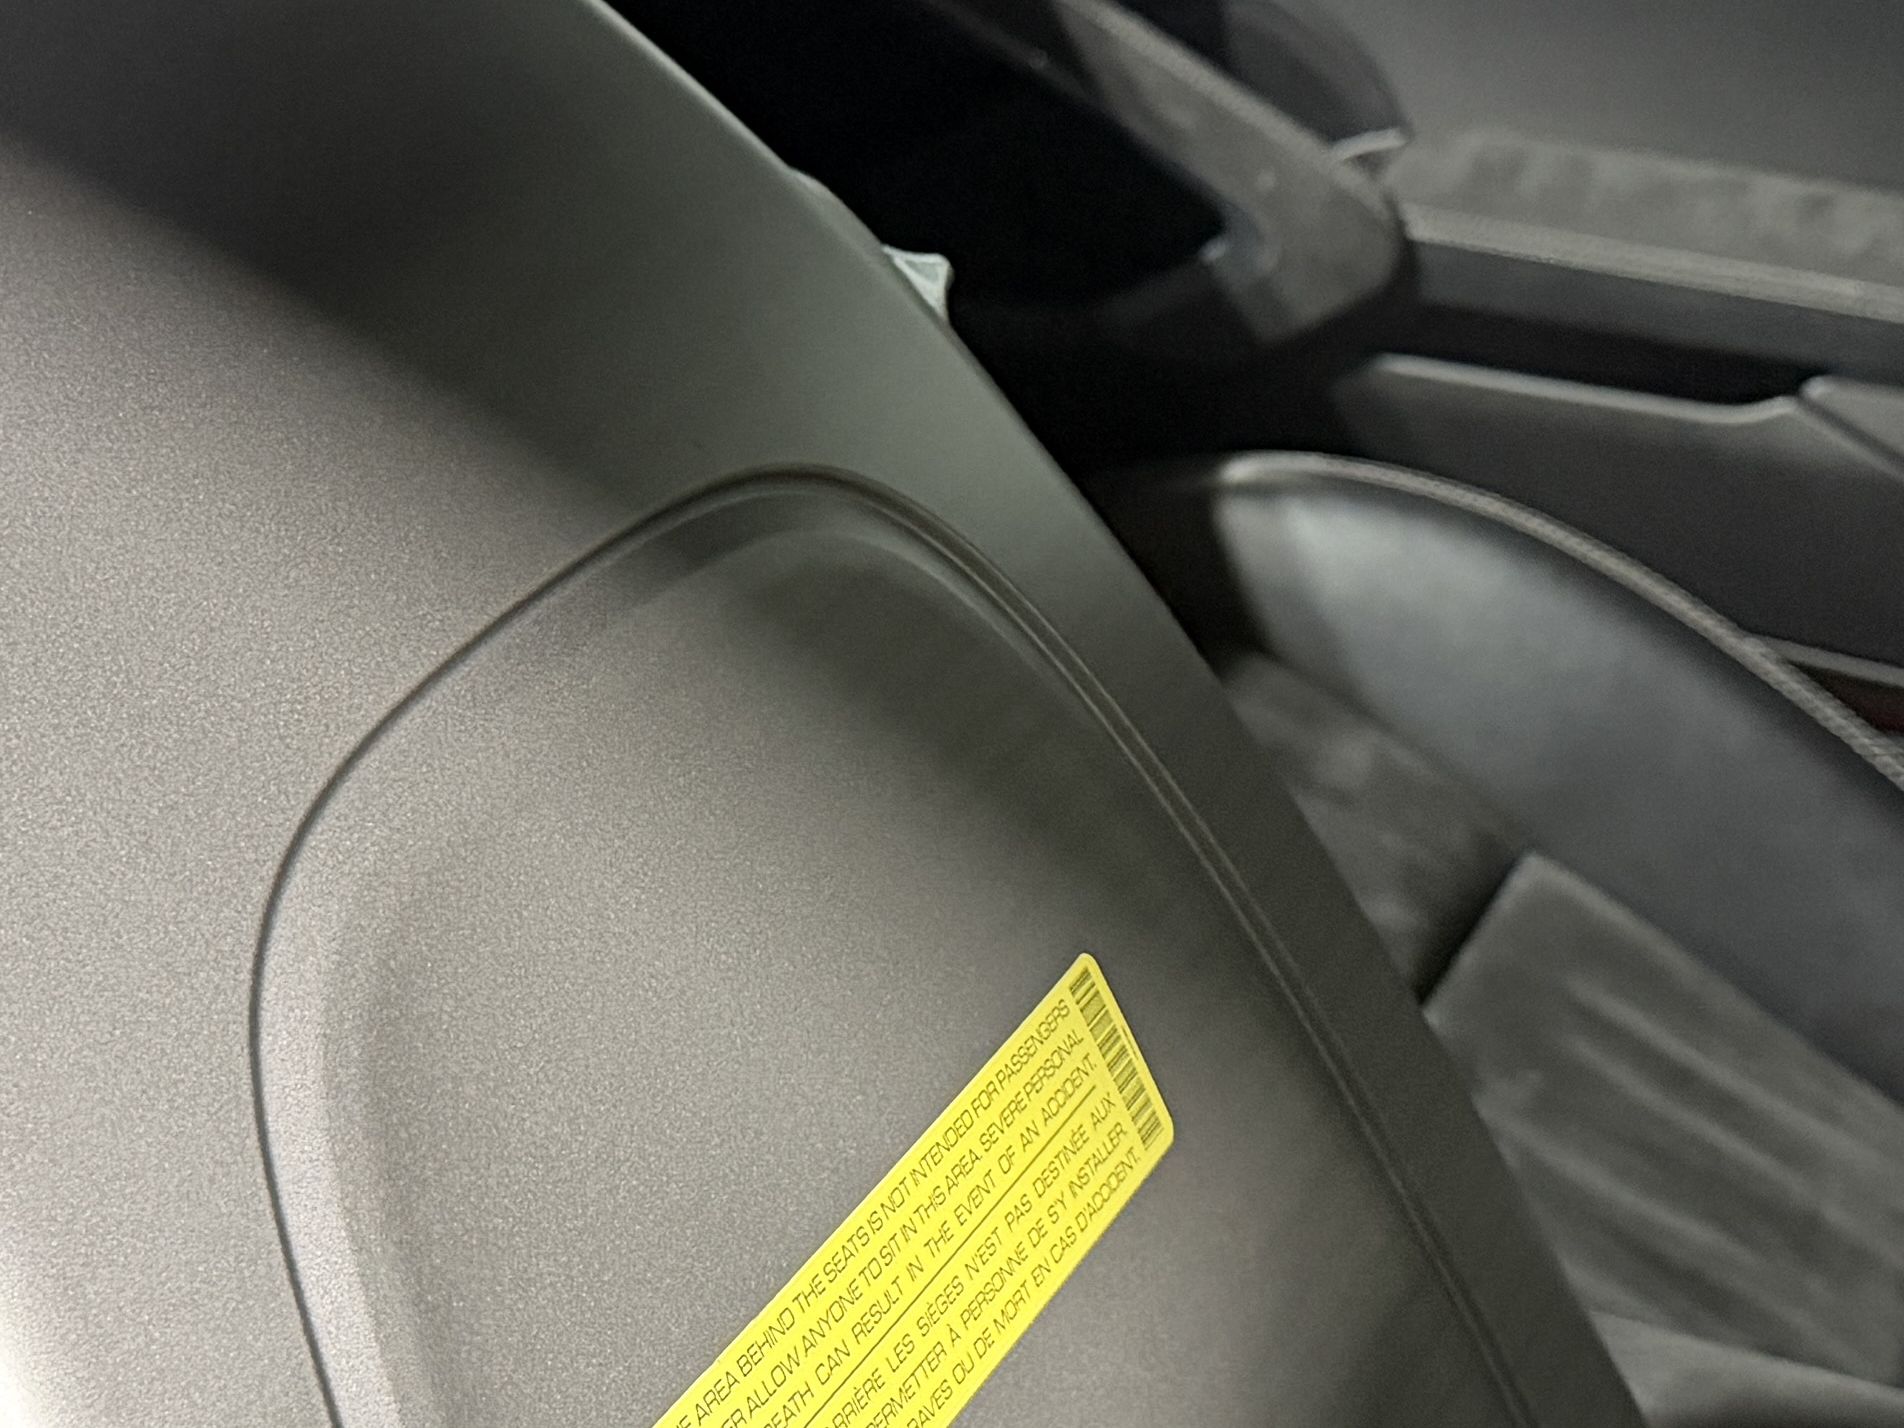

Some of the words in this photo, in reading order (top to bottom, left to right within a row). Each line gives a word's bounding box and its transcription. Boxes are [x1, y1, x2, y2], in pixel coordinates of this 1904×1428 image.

[695, 1370, 740, 1426] AREA
[735, 1307, 795, 1377] BEHIND
[791, 1272, 826, 1313] THE
[822, 1225, 870, 1283] SEATS
[866, 1210, 883, 1234] IS
[879, 1176, 910, 1220] NOT
[909, 1108, 974, 1187] INTENDED
[970, 1080, 1000, 1118] FOR
[994, 998, 1070, 1090] PASSENGERS
[746, 1345, 800, 1419] ALLOW
[801, 1277, 863, 1357] ANYONE
[858, 1256, 882, 1286] TO
[879, 1232, 901, 1266] SIT
[899, 1216, 917, 1243] IN
[912, 1185, 946, 1224] THIS
[944, 1148, 983, 1195] AREA.
[978, 1090, 1027, 1152] SEVERE
[1022, 1028, 1084, 1102] PERSONAL
[814, 1338, 850, 1385] CAN
[850, 1275, 903, 1344] RESULT
[905, 1254, 924, 1282] IN
[923, 1219, 954, 1257] THE
[953, 1168, 995, 1226] EVENT
[997, 1144, 1015, 1174] OF
[1019, 1119, 1040, 1152] AN
[1040, 1052, 1097, 1126] ACCIDENT.
[885, 1332, 915, 1372] LES
[916, 1274, 964, 1337] SIÈGES
[964, 1226, 1002, 1280] N'EST
[1004, 1193, 1032, 1232] PAS
[1031, 1123, 1089, 1198] DESTINÉE
[1090, 1091, 1116, 1130] AUX
[946, 1323, 961, 1347] À
[959, 1240, 1028, 1330] PERSONNE
[1026, 1217, 1048, 1248] DE
[1046, 1190, 1067, 1224] S'Y
[951, 1351, 974, 1384] OU
[972, 1326, 995, 1359] DE
[992, 1279, 1030, 1333] MORT
[1030, 1257, 1051, 1287] EN
[1049, 1225, 1076, 1264] CAS
